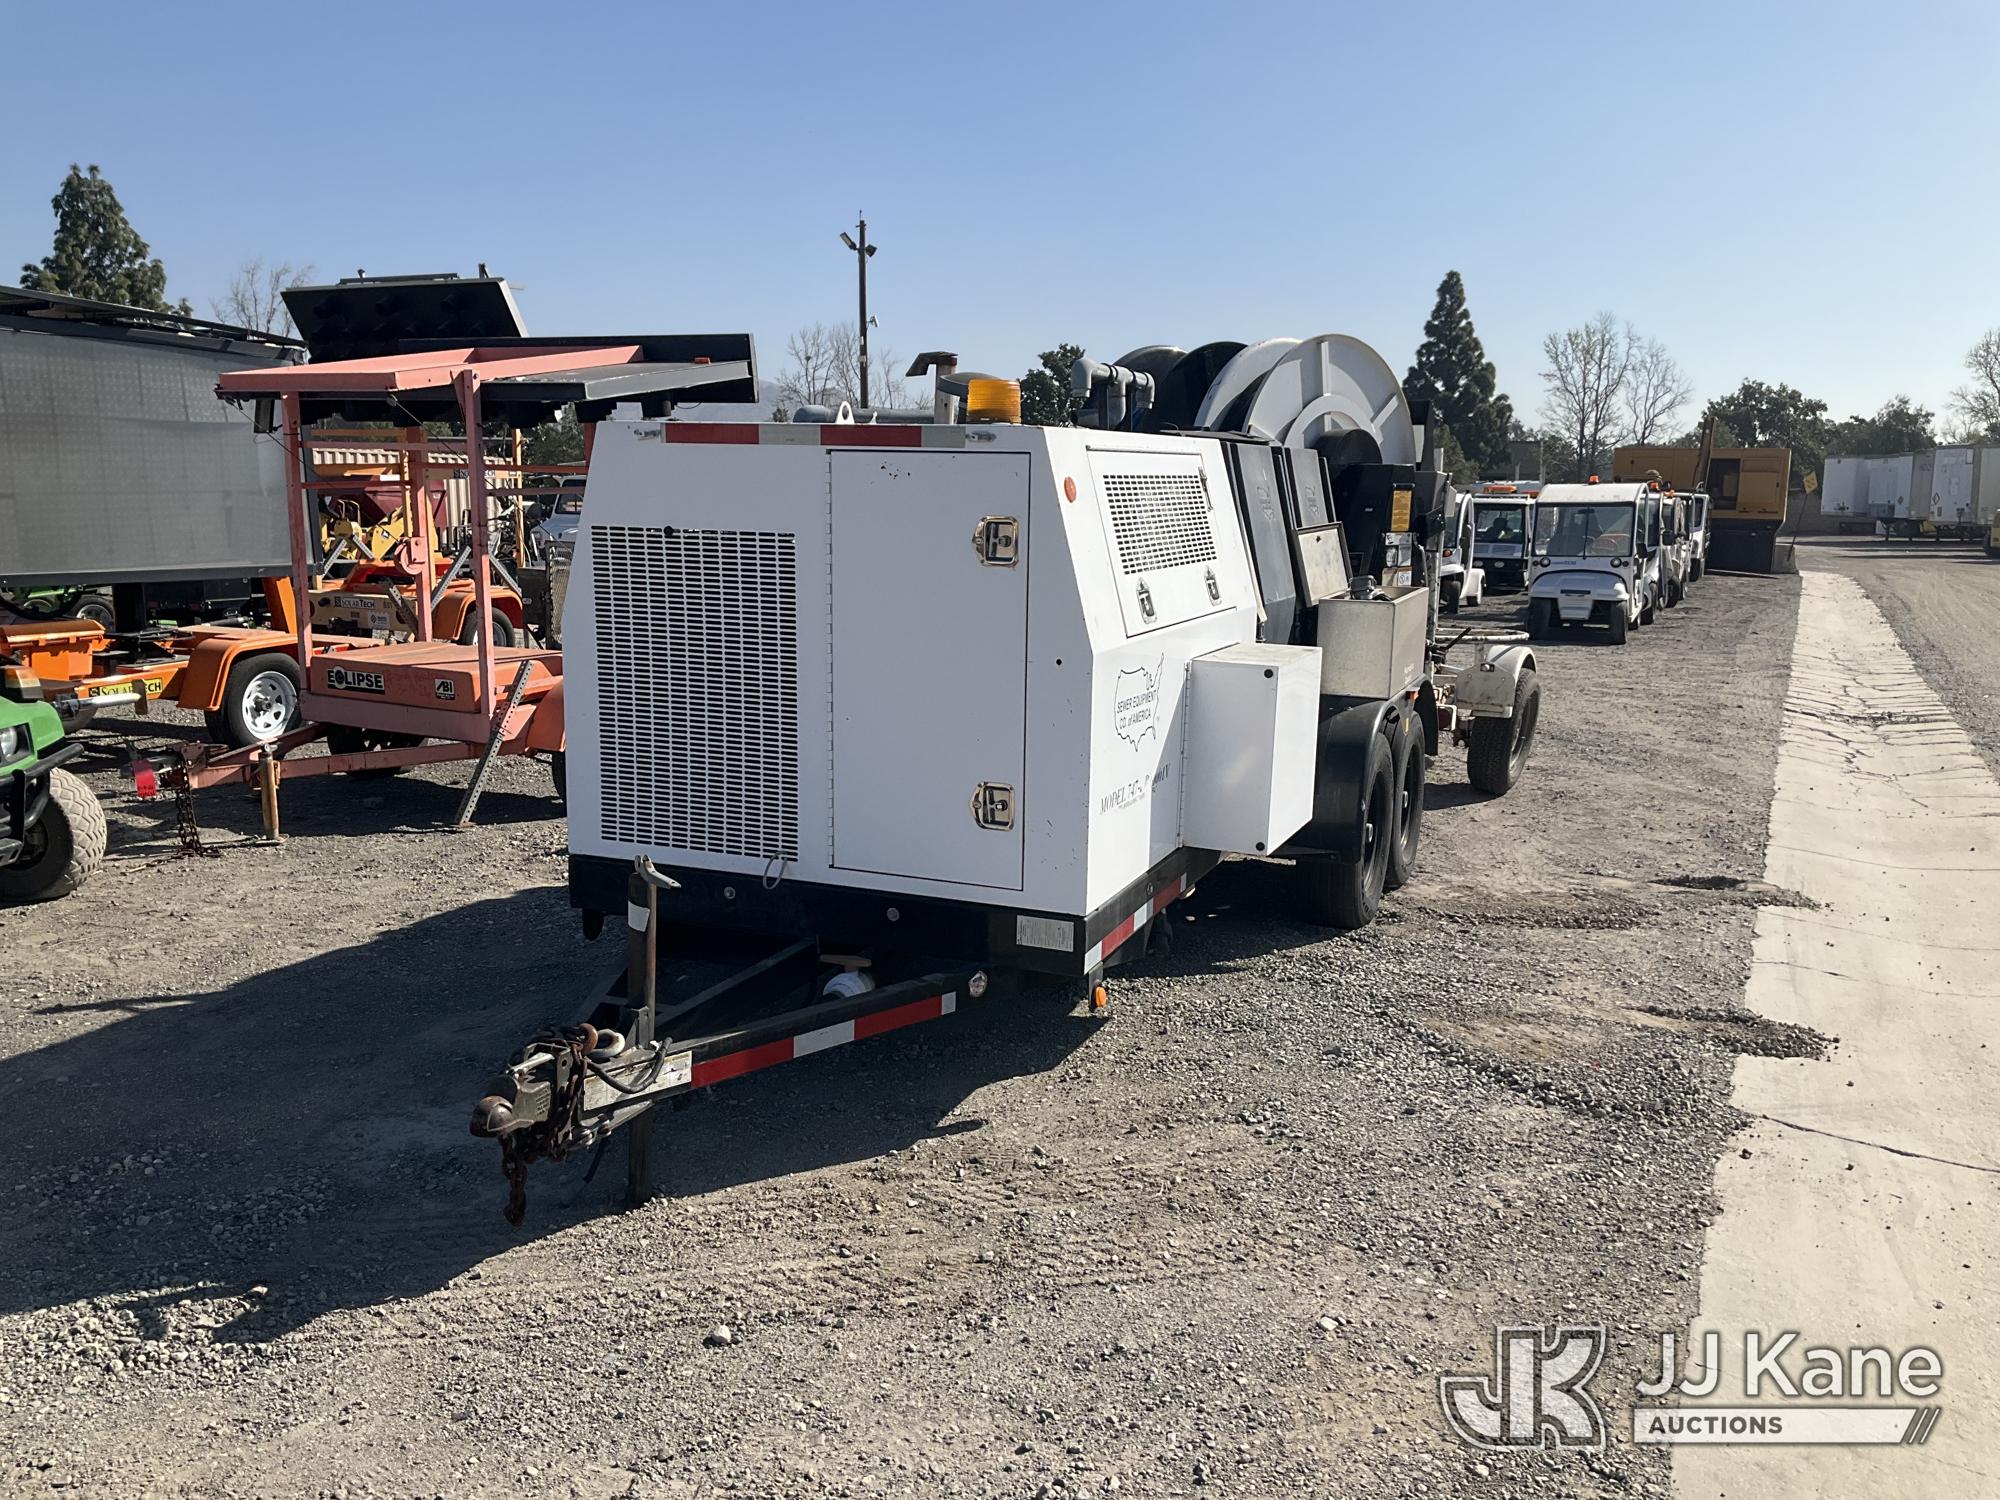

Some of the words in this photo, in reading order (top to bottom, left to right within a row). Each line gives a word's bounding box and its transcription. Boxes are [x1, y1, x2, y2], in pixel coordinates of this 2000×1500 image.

[1117, 698, 1133, 714] SEWER
[1132, 690, 1156, 708] EQUIPMENT
[1132, 708, 1151, 722] AMERICA
